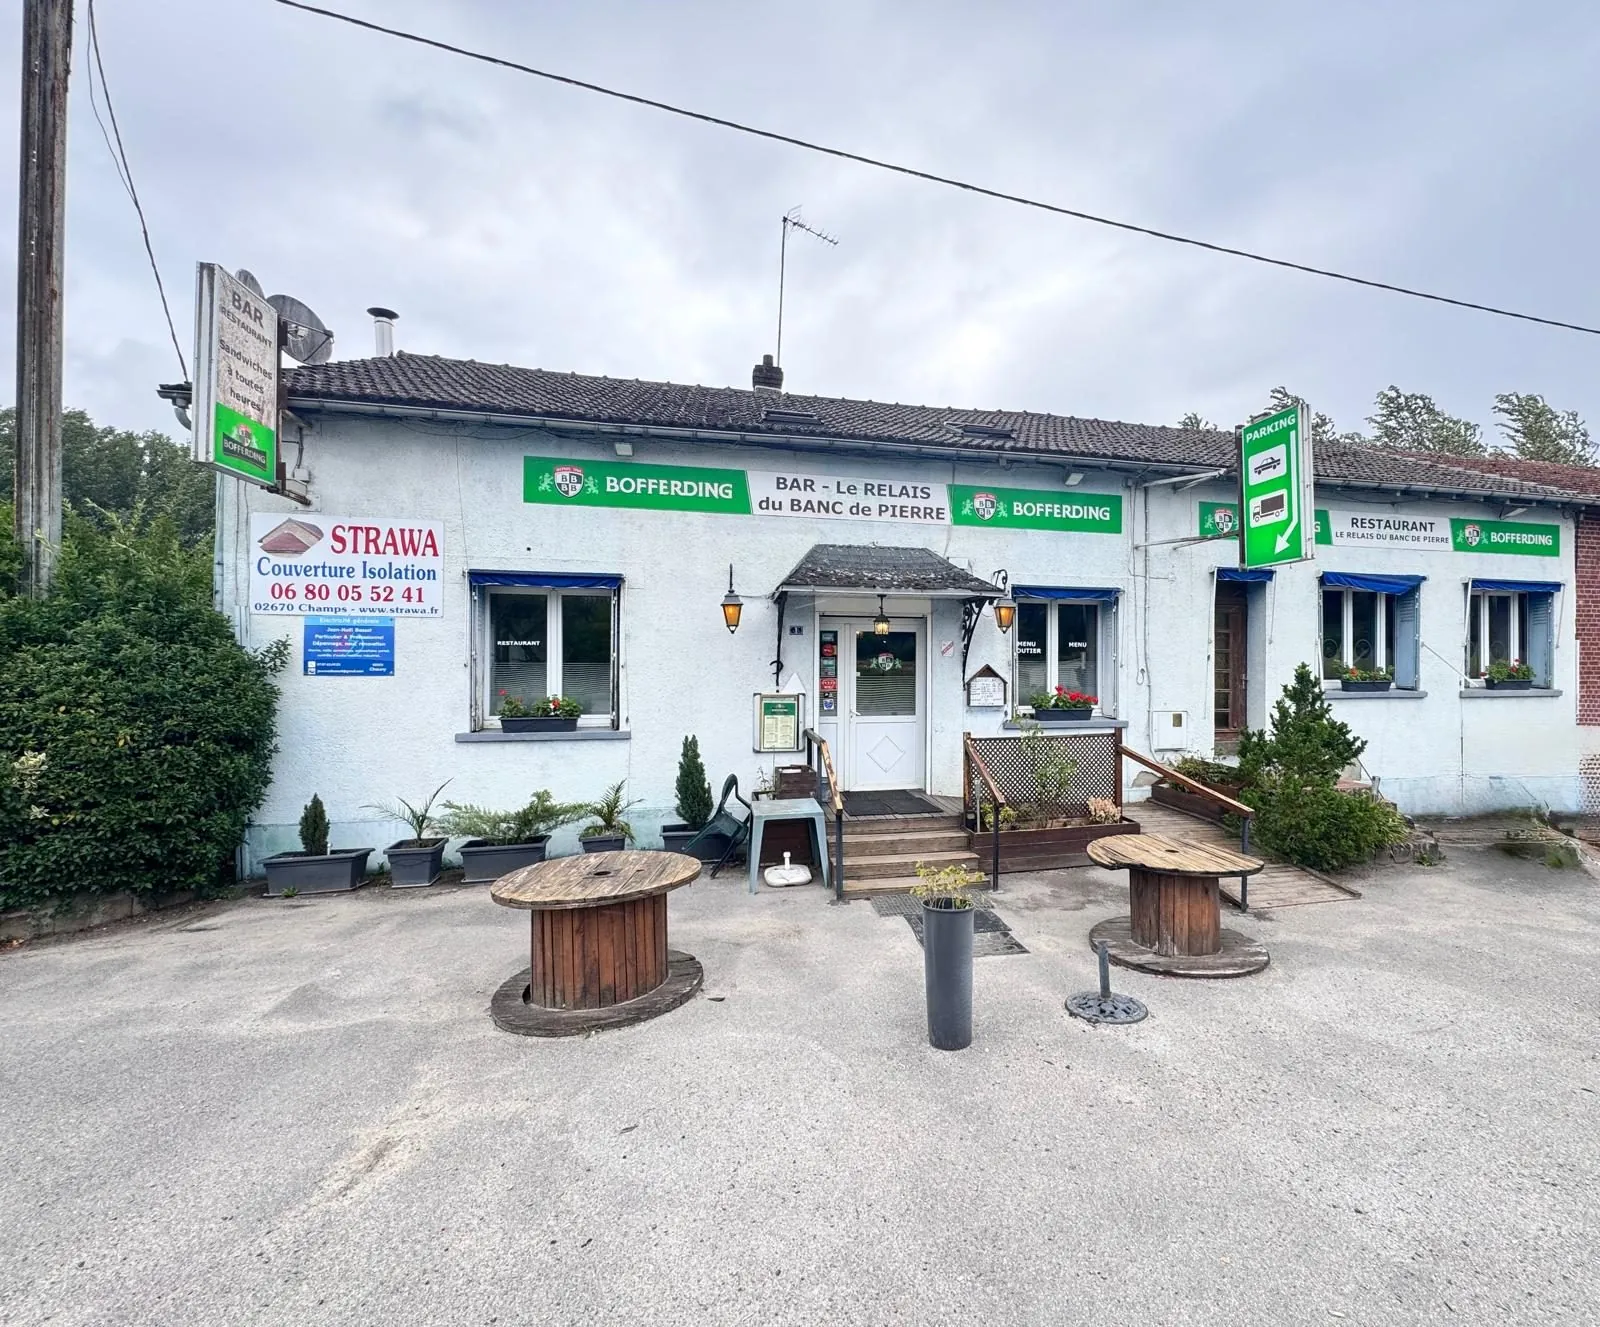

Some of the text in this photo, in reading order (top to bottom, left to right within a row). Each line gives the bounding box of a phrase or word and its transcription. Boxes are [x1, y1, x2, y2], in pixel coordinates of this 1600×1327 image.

[232, 290, 263, 329] BAR
[221, 305, 272, 348] RESTAURANT
[220, 339, 272, 380] Sandwiches
[236, 370, 264, 394] toutes
[230, 387, 261, 412] heures
[1246, 414, 1296, 444] PARKING
[223, 438, 266, 464] BOFFERDING
[606, 476, 733, 499] BOFFERDING
[776, 476, 816, 492] BAR
[836, 481, 858, 495] Le
[864, 483, 931, 499] RELAIS
[758, 497, 945, 520] du BANC de PIERRE
[1013, 502, 1110, 521] BOFFERDING
[1351, 517, 1435, 533] RESTAURANT
[330, 525, 439, 557] STRAWA
[1346, 532, 1374, 541] RELAIS
[1389, 534, 1409, 542] BANC
[1411, 535, 1422, 543] DE
[1423, 536, 1449, 544] PIERRE
[1490, 532, 1553, 545] BOFFERDING
[257, 556, 436, 581] Couverture Isolation
[271, 582, 424, 603] 06 80 05 52 41
[254, 602, 294, 611] 02670
[298, 603, 347, 614] Champs
[359, 605, 439, 615] www.strawa.fr
